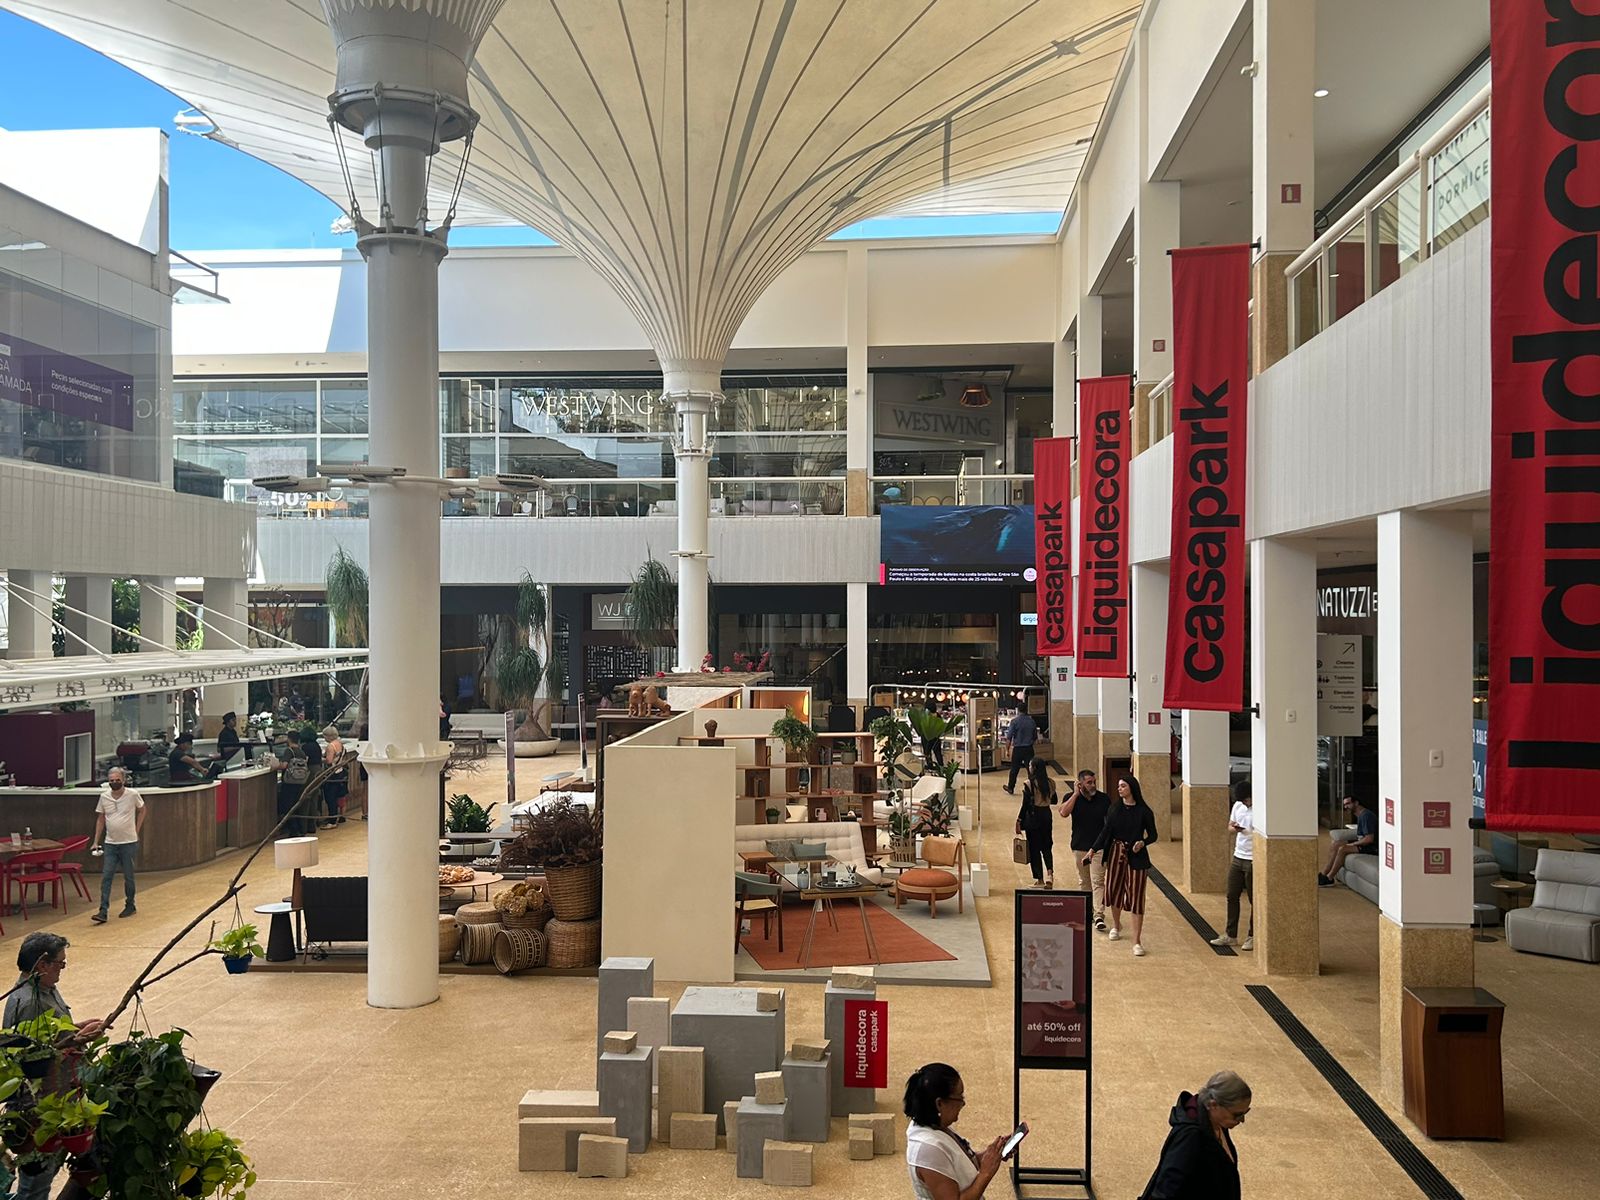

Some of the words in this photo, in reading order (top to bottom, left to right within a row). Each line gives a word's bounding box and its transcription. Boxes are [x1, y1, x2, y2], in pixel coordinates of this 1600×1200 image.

[519, 395, 654, 416] WESTWING
[893, 408, 991, 437] WESTWING
[1084, 411, 1124, 659] Liquidecora
[1180, 380, 1240, 682] casapark
[1039, 502, 1068, 645] casapark
[1316, 586, 1371, 618] NATUZZI
[856, 1009, 869, 1079] liquidecora
[869, 1010, 880, 1053] casapark
[1027, 1022, 1042, 1031] até
[1044, 1022, 1066, 1031] 50%
[1068, 1023, 1081, 1031] off
[1044, 1035, 1082, 1043] liquidecora
